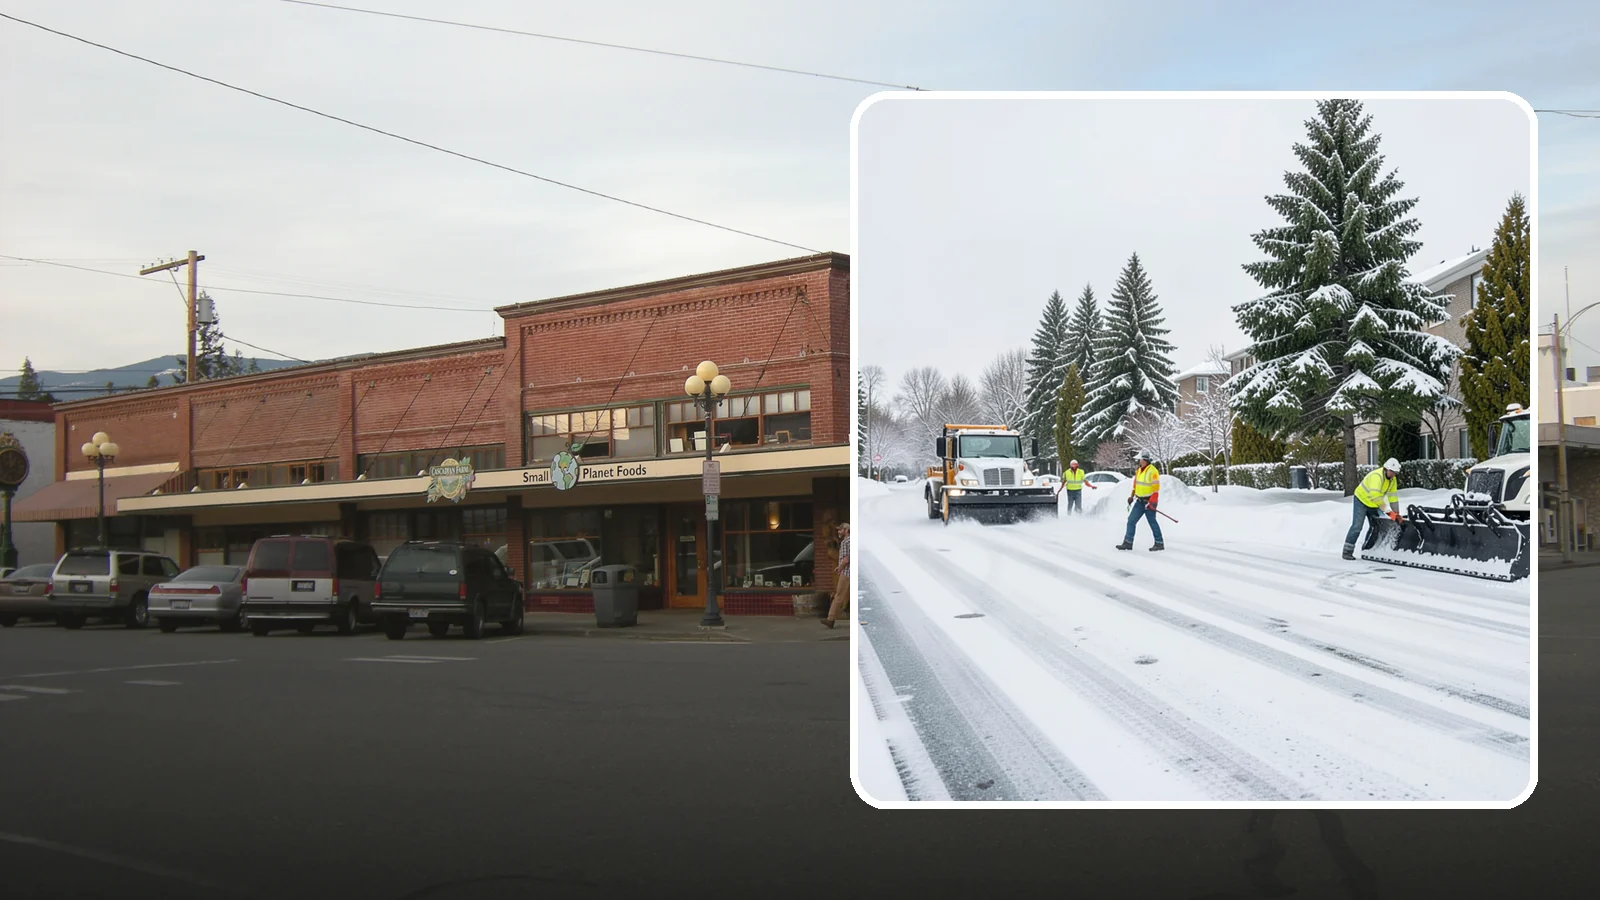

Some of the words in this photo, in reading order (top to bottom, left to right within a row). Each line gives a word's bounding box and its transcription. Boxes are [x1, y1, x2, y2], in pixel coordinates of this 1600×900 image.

[523, 471, 549, 483] Small
[582, 467, 613, 479] Planet
[617, 464, 647, 477] Foods
